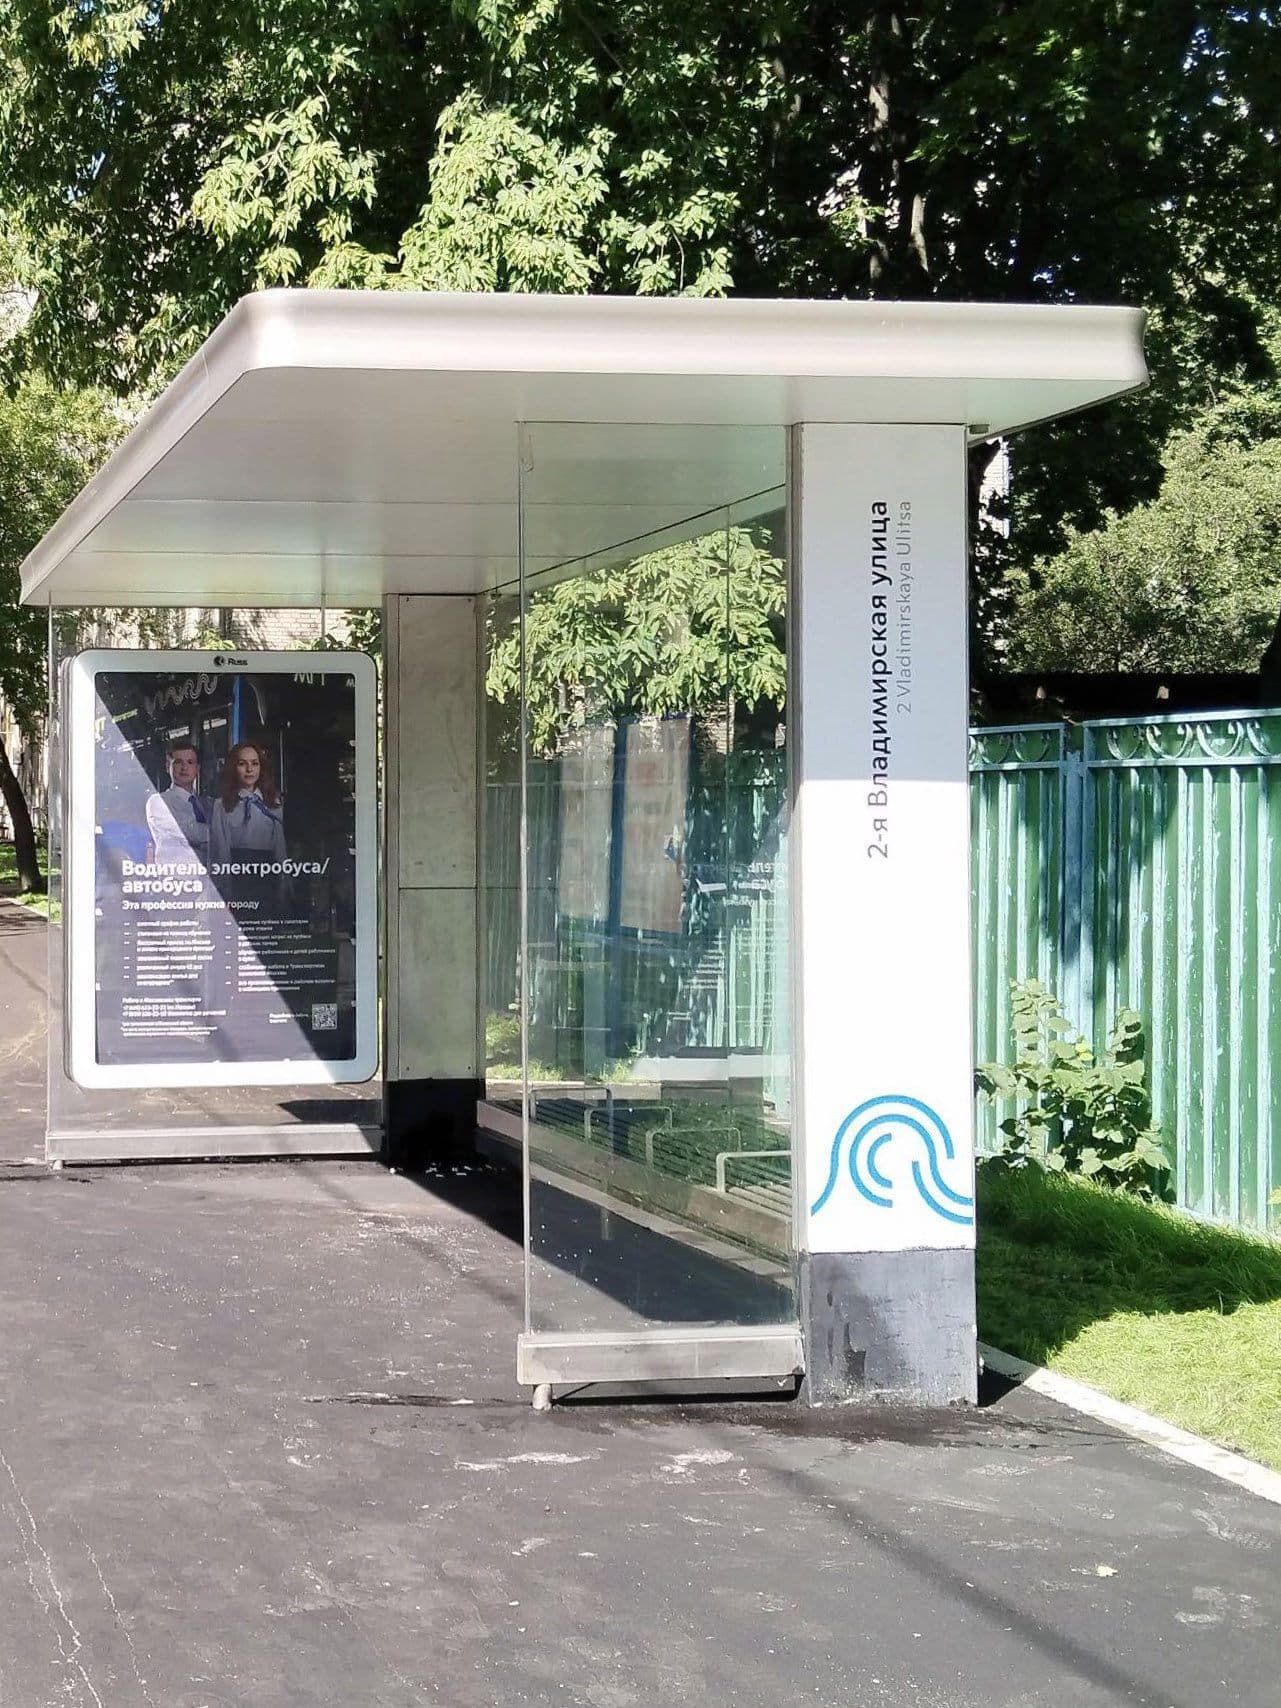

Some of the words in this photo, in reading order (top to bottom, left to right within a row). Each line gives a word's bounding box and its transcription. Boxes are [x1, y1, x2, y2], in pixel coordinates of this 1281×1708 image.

[869, 501, 892, 585] улица
[896, 501, 912, 555] Ulitsa
[896, 562, 914, 698] Vladimirskaya
[866, 595, 892, 807] Владимирская
[897, 702, 911, 713] 2
[866, 818, 889, 858] 2-я
[122, 859, 207, 878] Водитель
[212, 857, 330, 878] электробуса/
[122, 877, 202, 897] автобуса
[141, 901, 193, 912] профессия
[194, 901, 225, 911] нужна
[228, 901, 260, 911] городу
